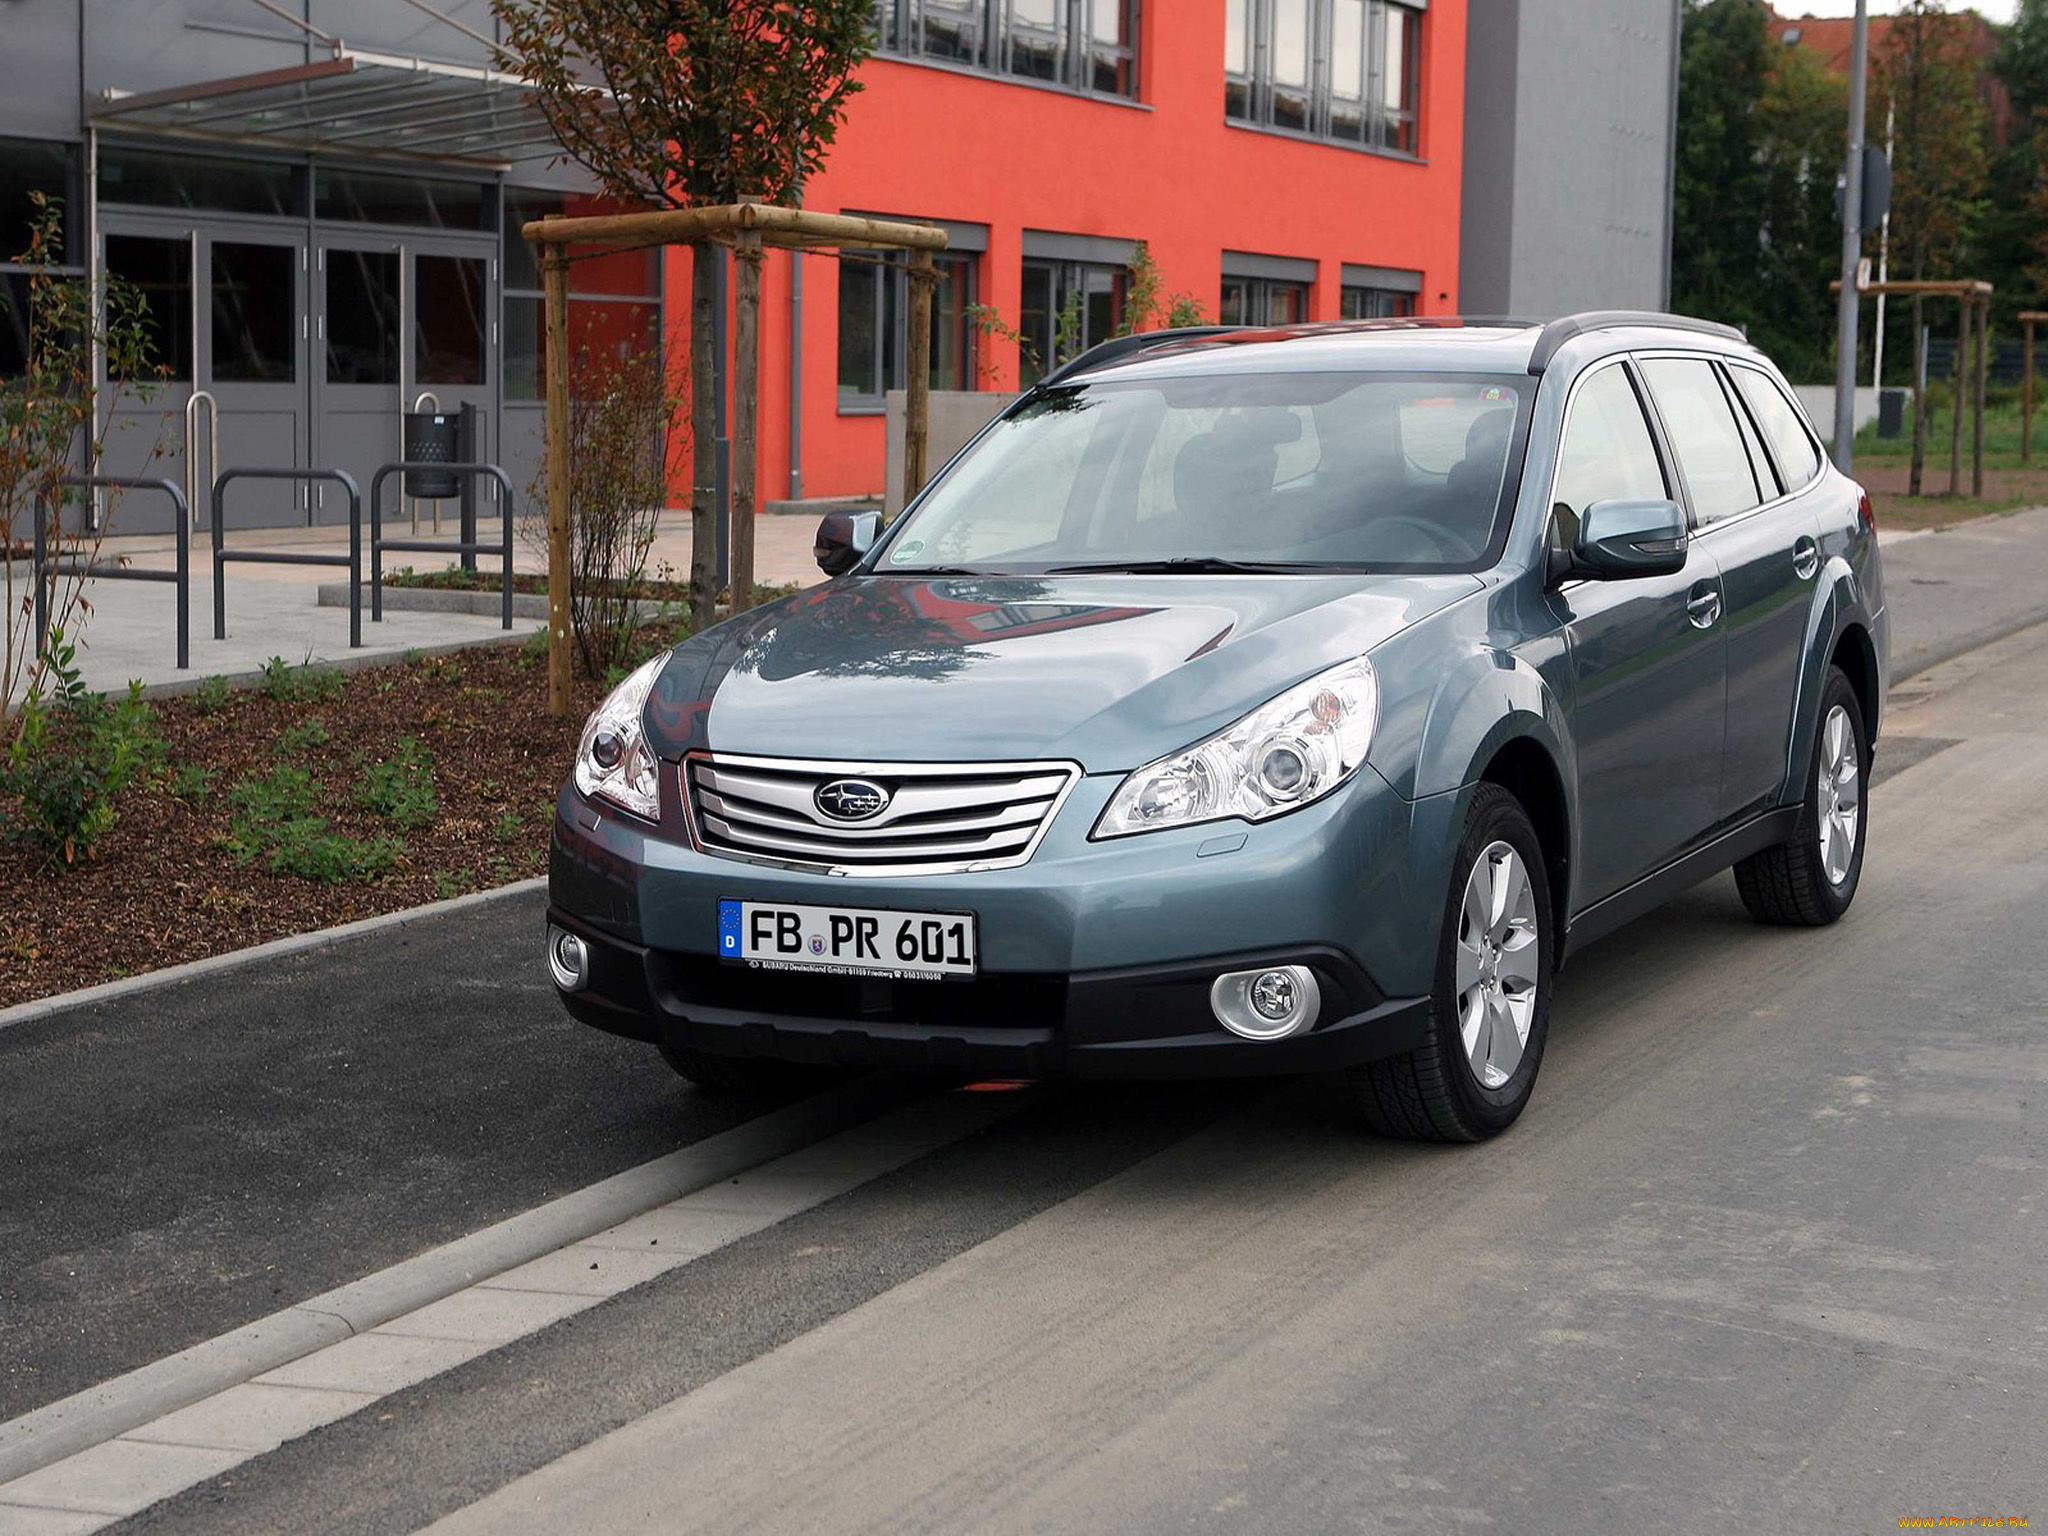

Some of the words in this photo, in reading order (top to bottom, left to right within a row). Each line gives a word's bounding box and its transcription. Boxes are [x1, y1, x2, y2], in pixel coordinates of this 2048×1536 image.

[725, 936, 735, 948] D
[751, 910, 803, 954] FB
[829, 914, 881, 960] PR
[896, 919, 971, 966] 601
